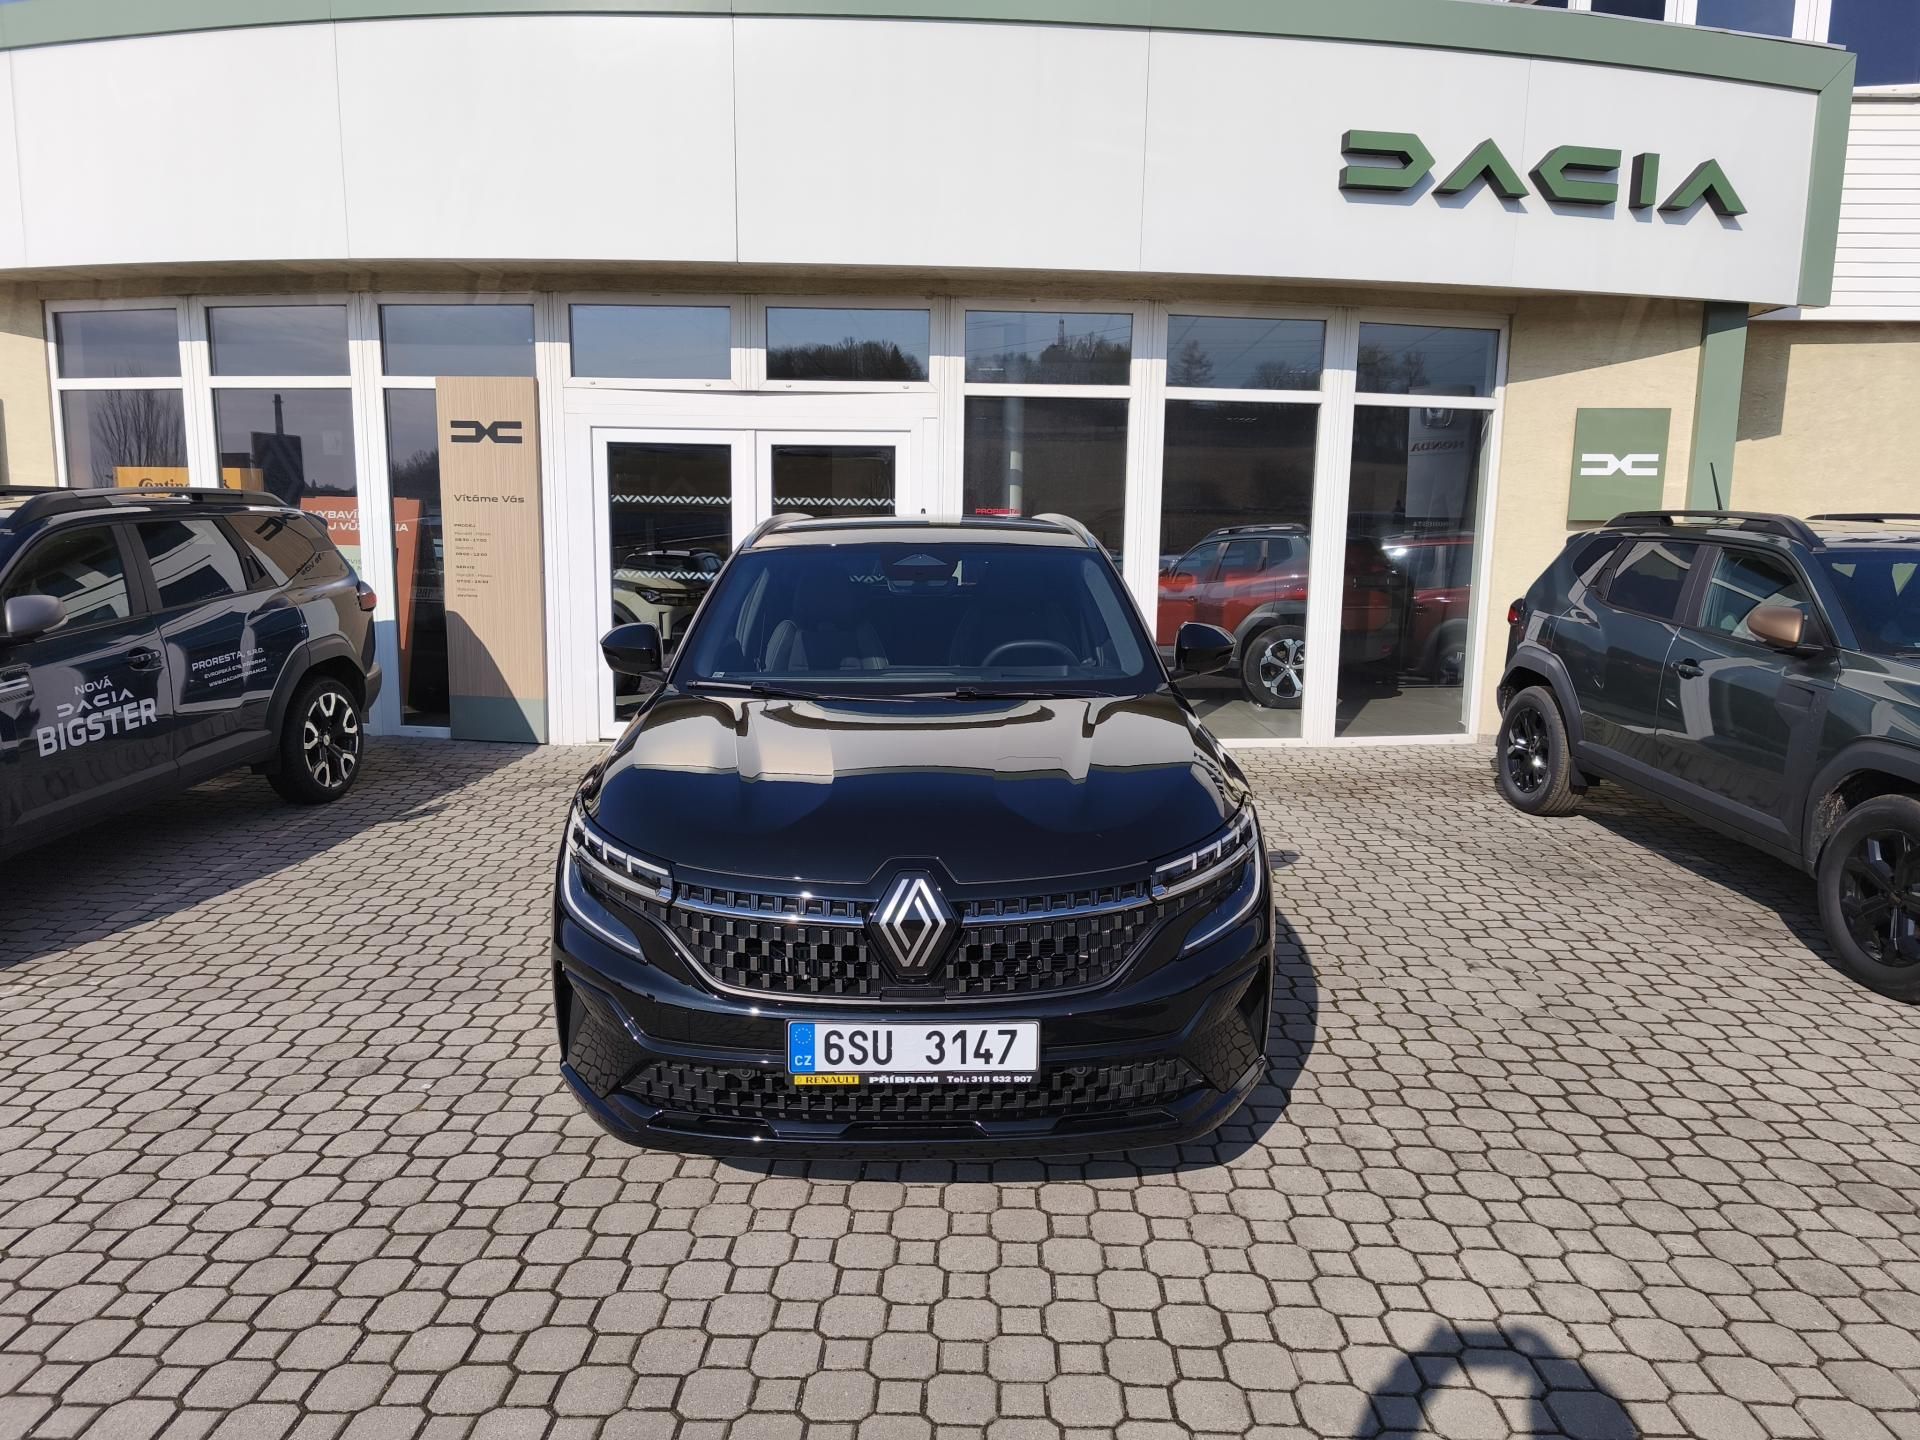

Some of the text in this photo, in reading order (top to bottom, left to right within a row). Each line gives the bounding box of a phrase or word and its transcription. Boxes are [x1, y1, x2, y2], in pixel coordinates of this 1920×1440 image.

[1338, 129, 1748, 217] DACIA
[454, 493, 525, 504] Vítáme Vás
[191, 650, 245, 672] PRORESTA,
[74, 675, 113, 695] NOVÁ
[56, 687, 135, 718] DACIA
[36, 697, 158, 758] BIGSTER
[824, 1029, 1018, 1066] 6SU 3147
[794, 1055, 812, 1066] CZ
[805, 1076, 857, 1084] RENAULT
[868, 1074, 939, 1084] PŘÍBRAM
[992, 1075, 1011, 1083] 632
[1013, 1075, 1033, 1083] 907
